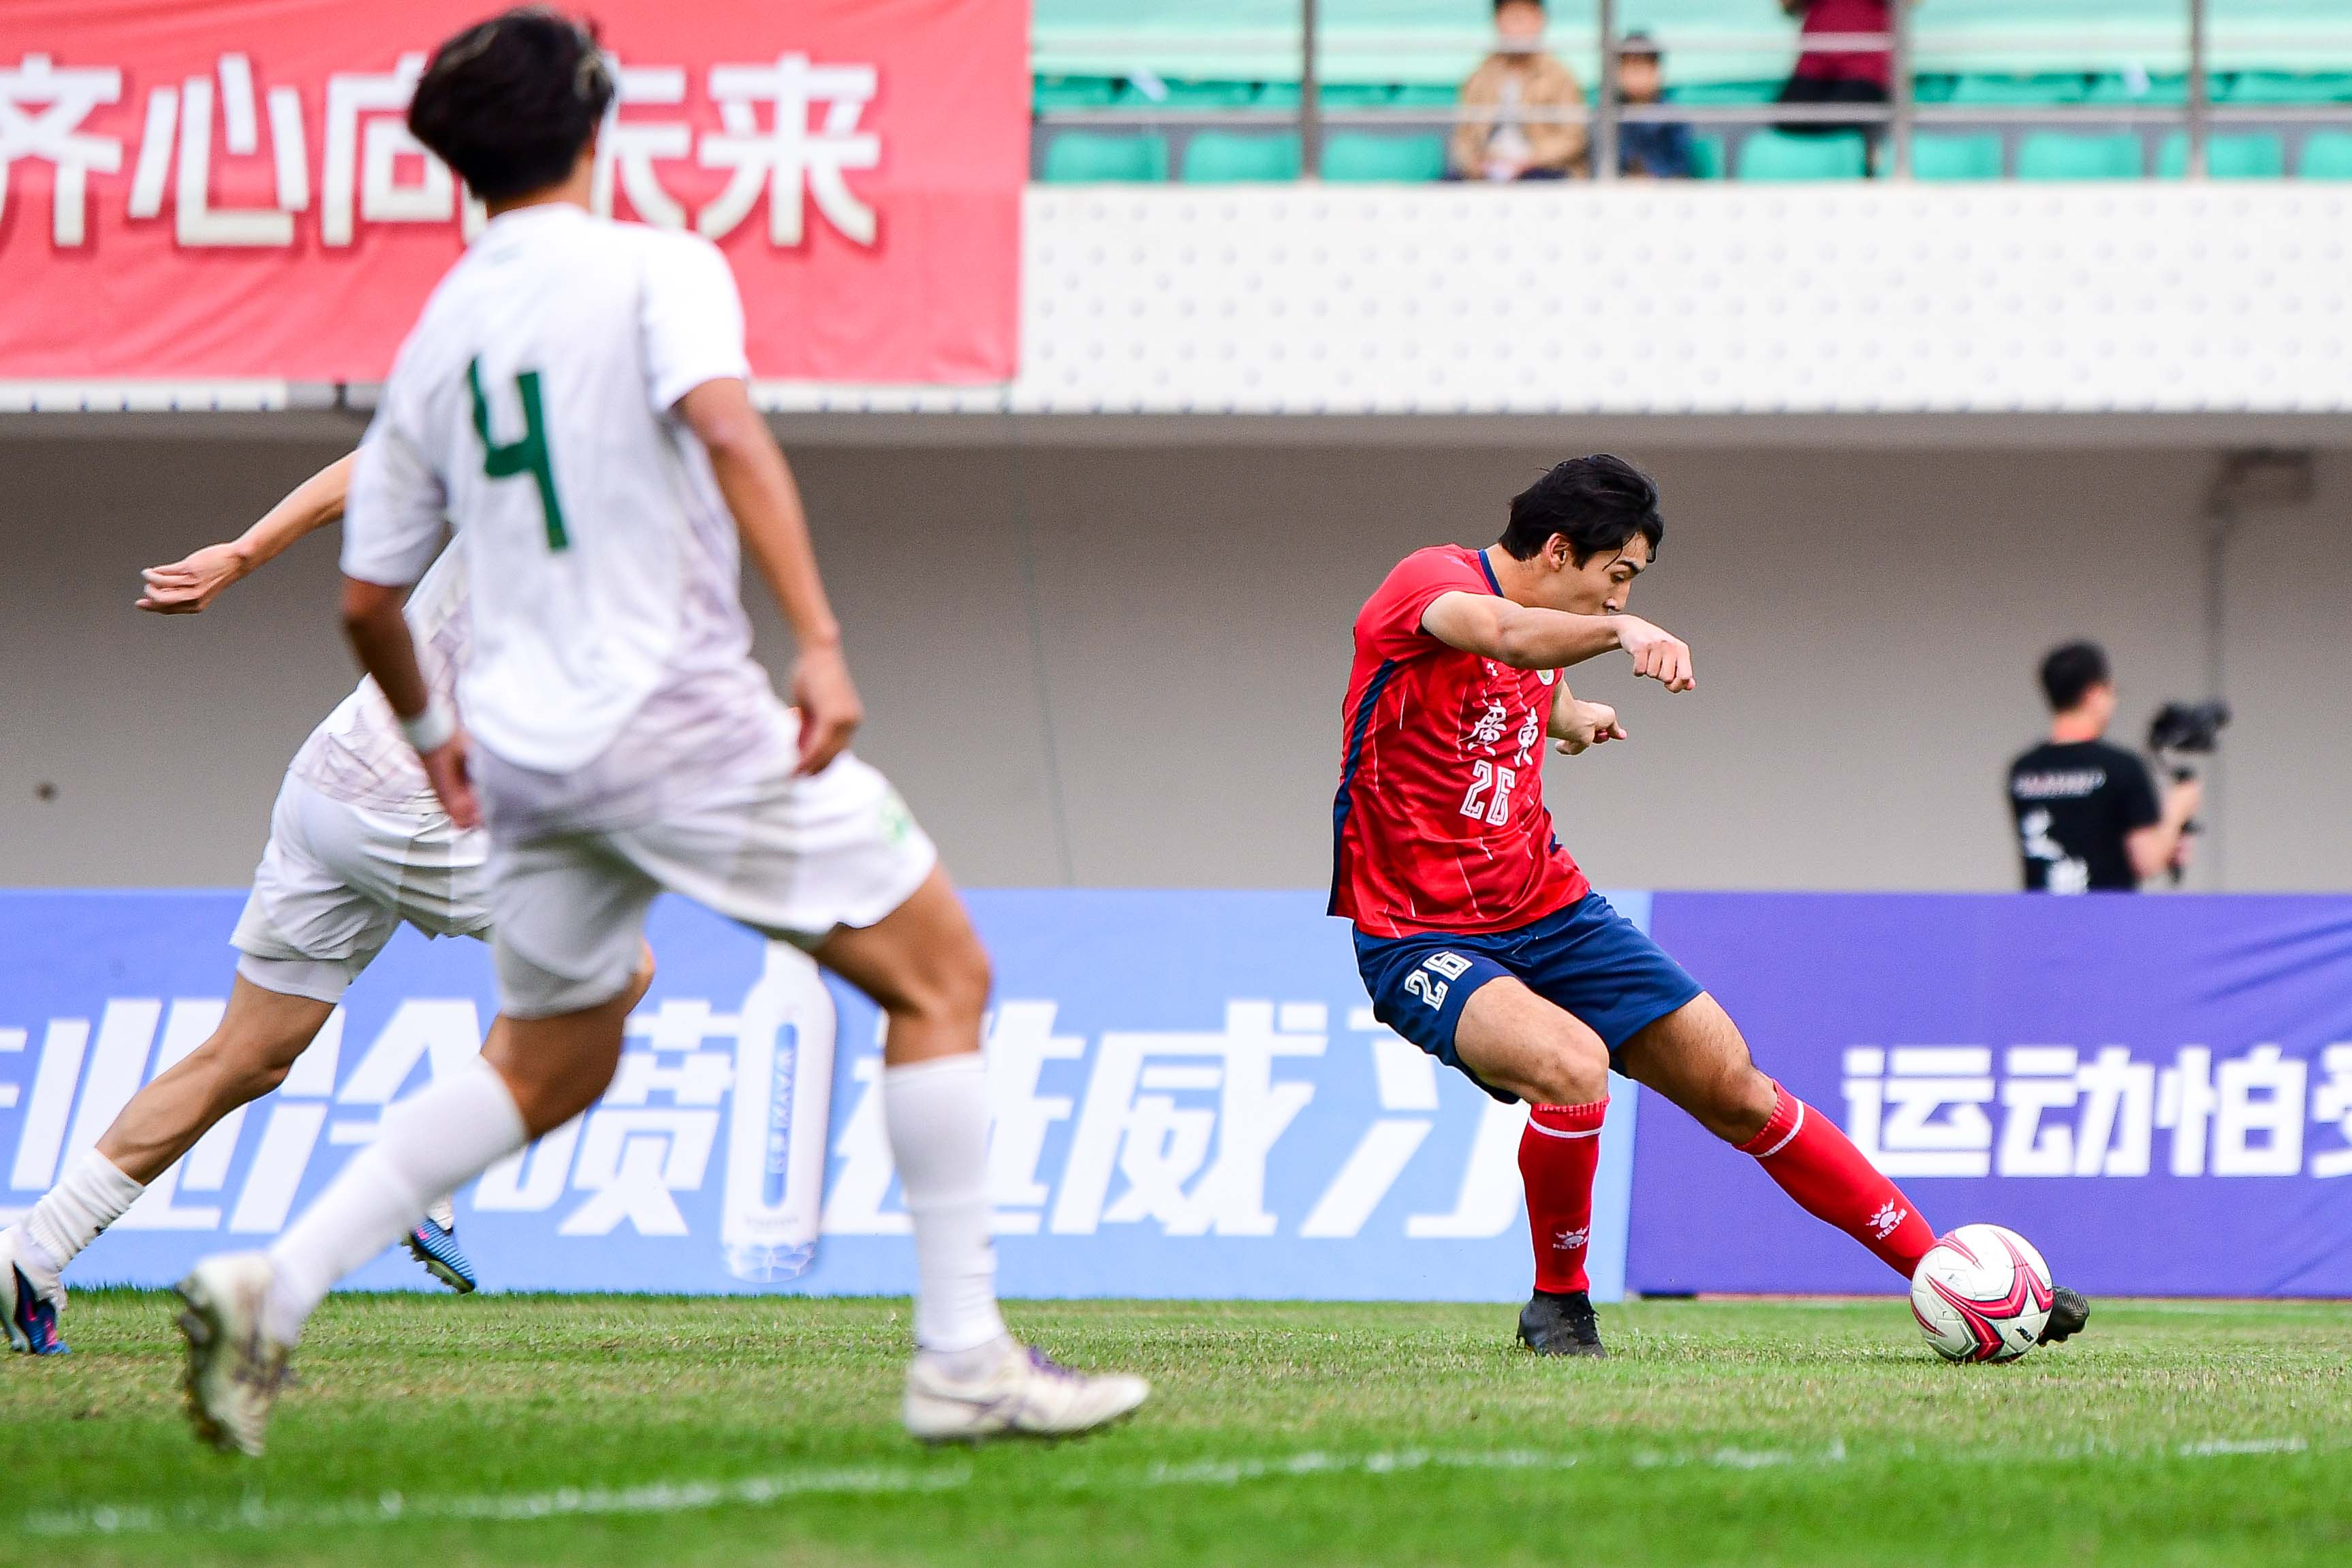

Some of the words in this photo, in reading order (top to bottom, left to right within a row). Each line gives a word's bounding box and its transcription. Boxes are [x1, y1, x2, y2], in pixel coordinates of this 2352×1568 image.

[467, 353, 569, 550] 4
[1460, 759, 1516, 826] 26
[1405, 951, 1473, 1012] 26
[1875, 1208, 1907, 1240] KELME
